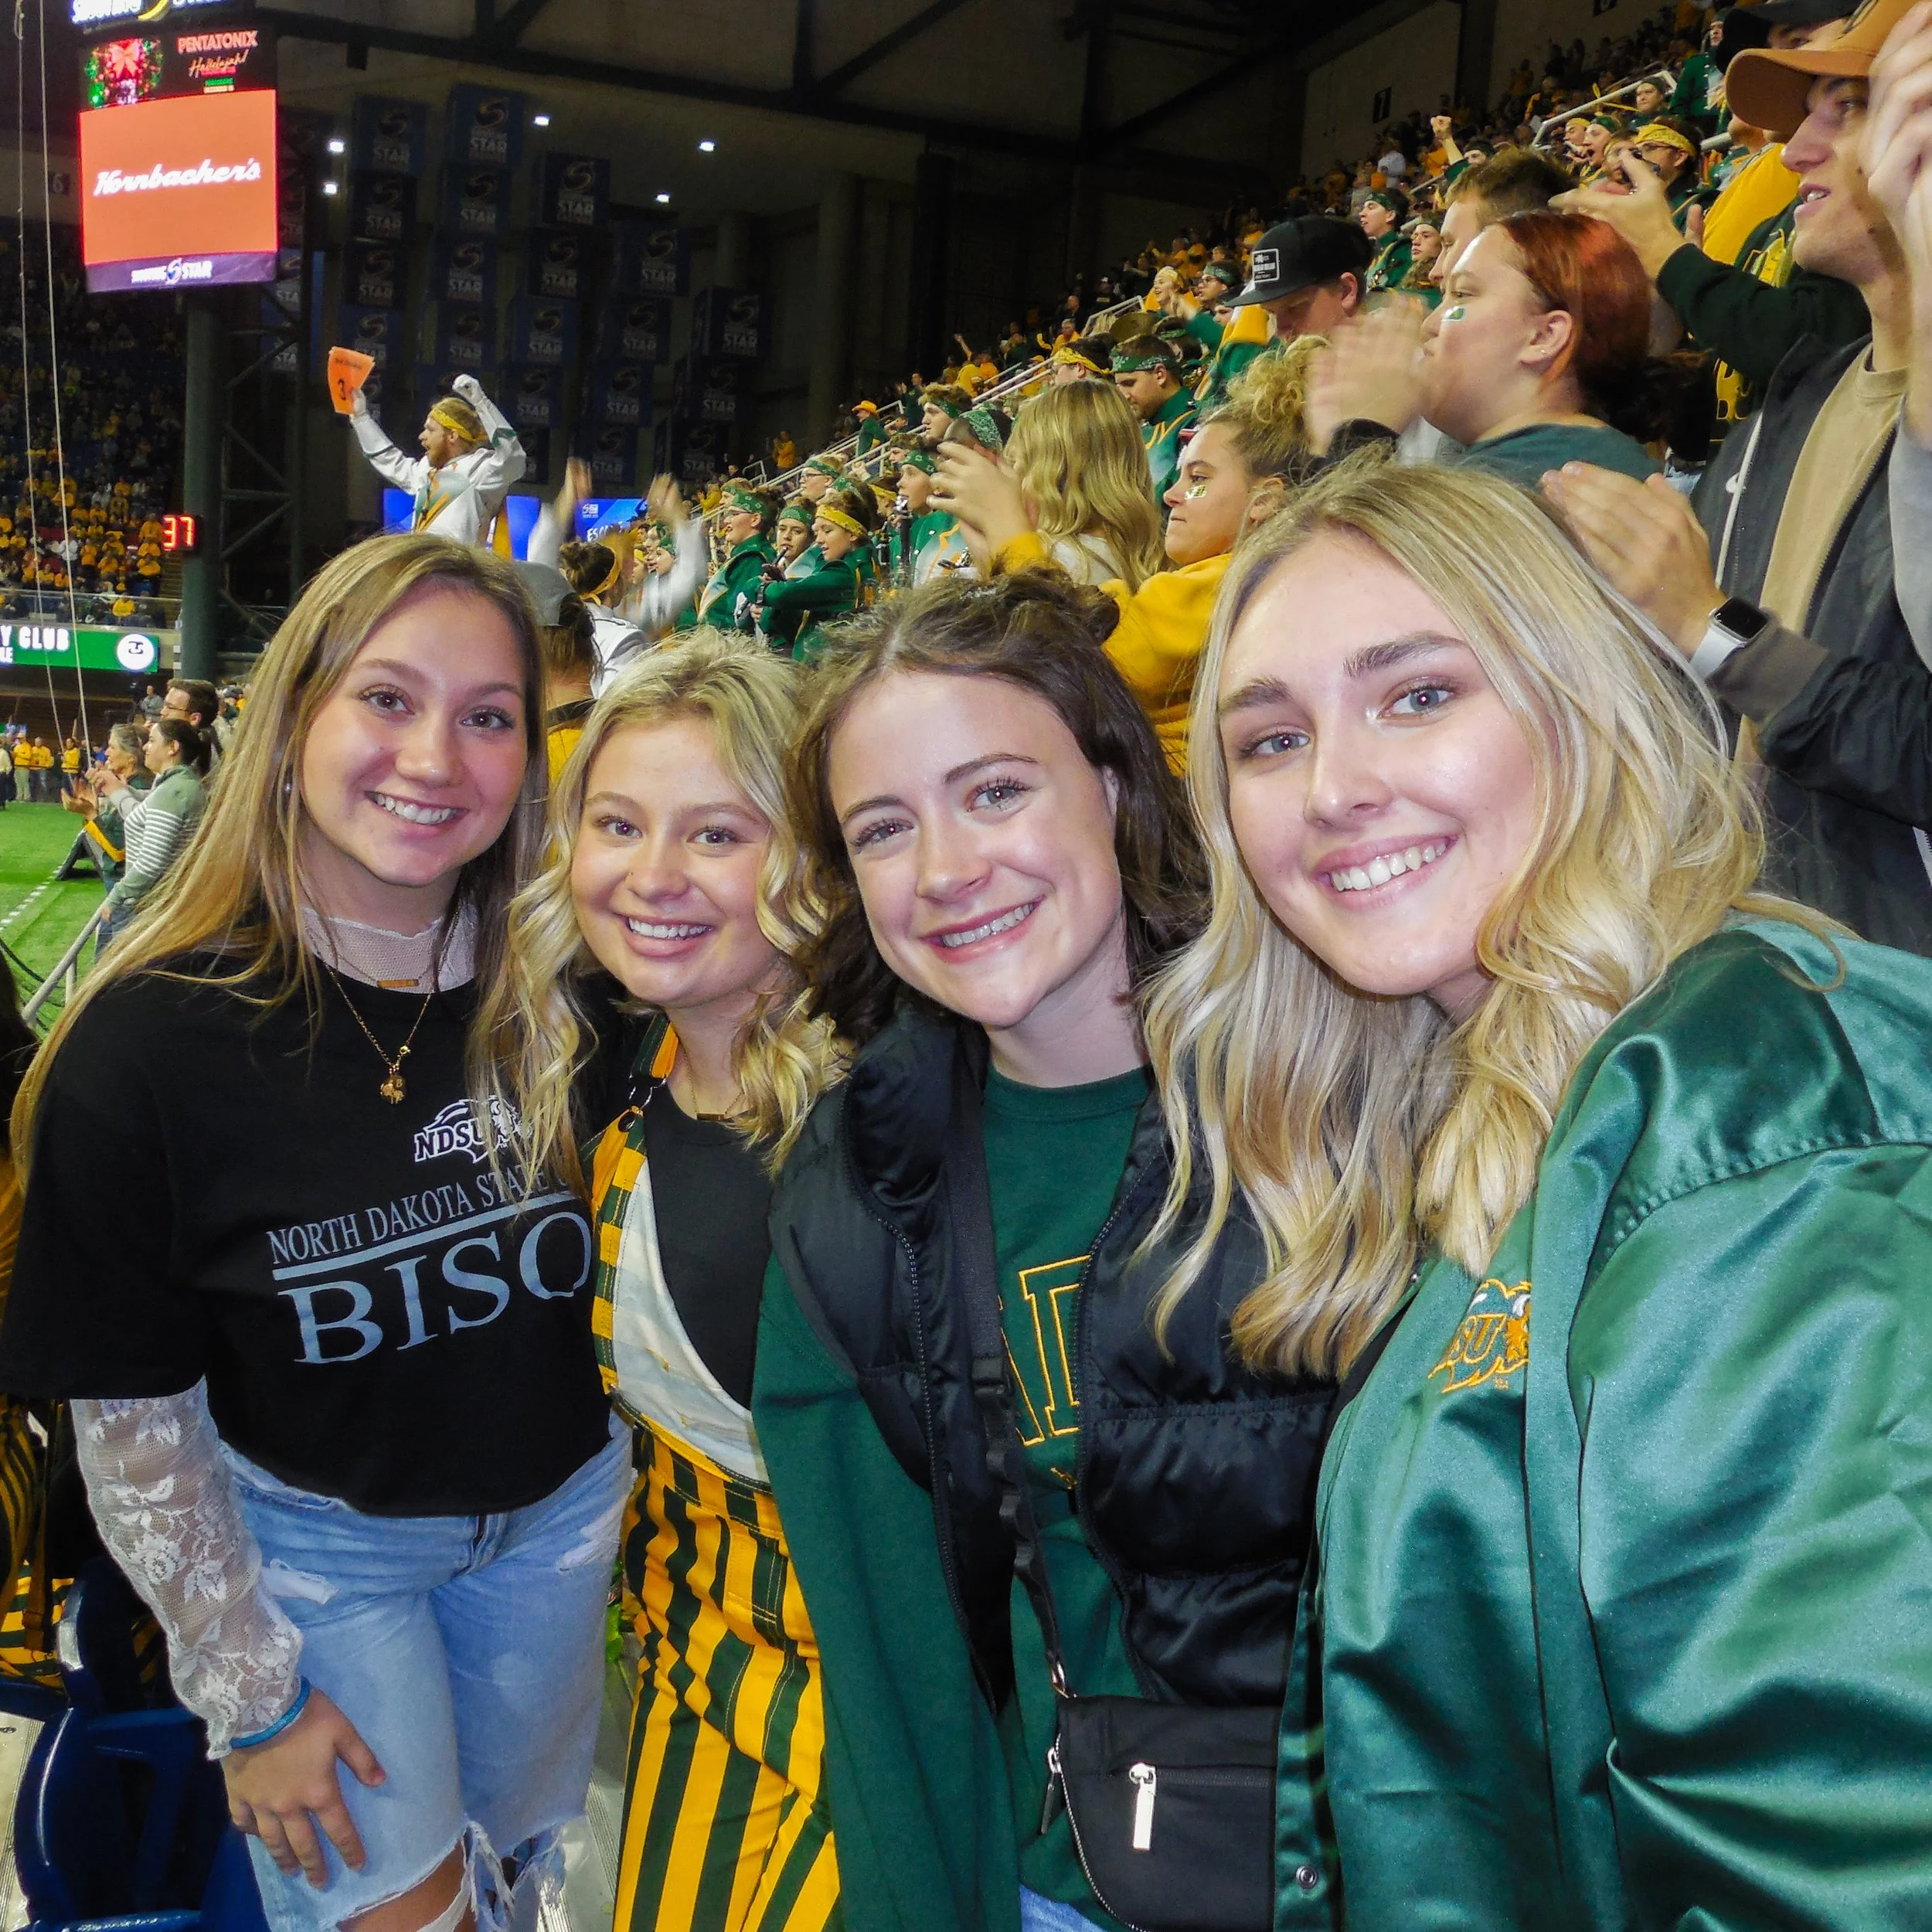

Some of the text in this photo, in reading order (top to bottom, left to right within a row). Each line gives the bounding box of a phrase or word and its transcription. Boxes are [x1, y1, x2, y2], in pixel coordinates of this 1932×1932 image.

[178, 31, 258, 54] PENTATONIX
[448, 278, 483, 293] STAR
[723, 335, 758, 348] STAR
[163, 515, 195, 550] 37
[19, 626, 70, 651] CLUB
[266, 1214, 362, 1264] NORTH
[365, 1182, 474, 1243] DAKOTA
